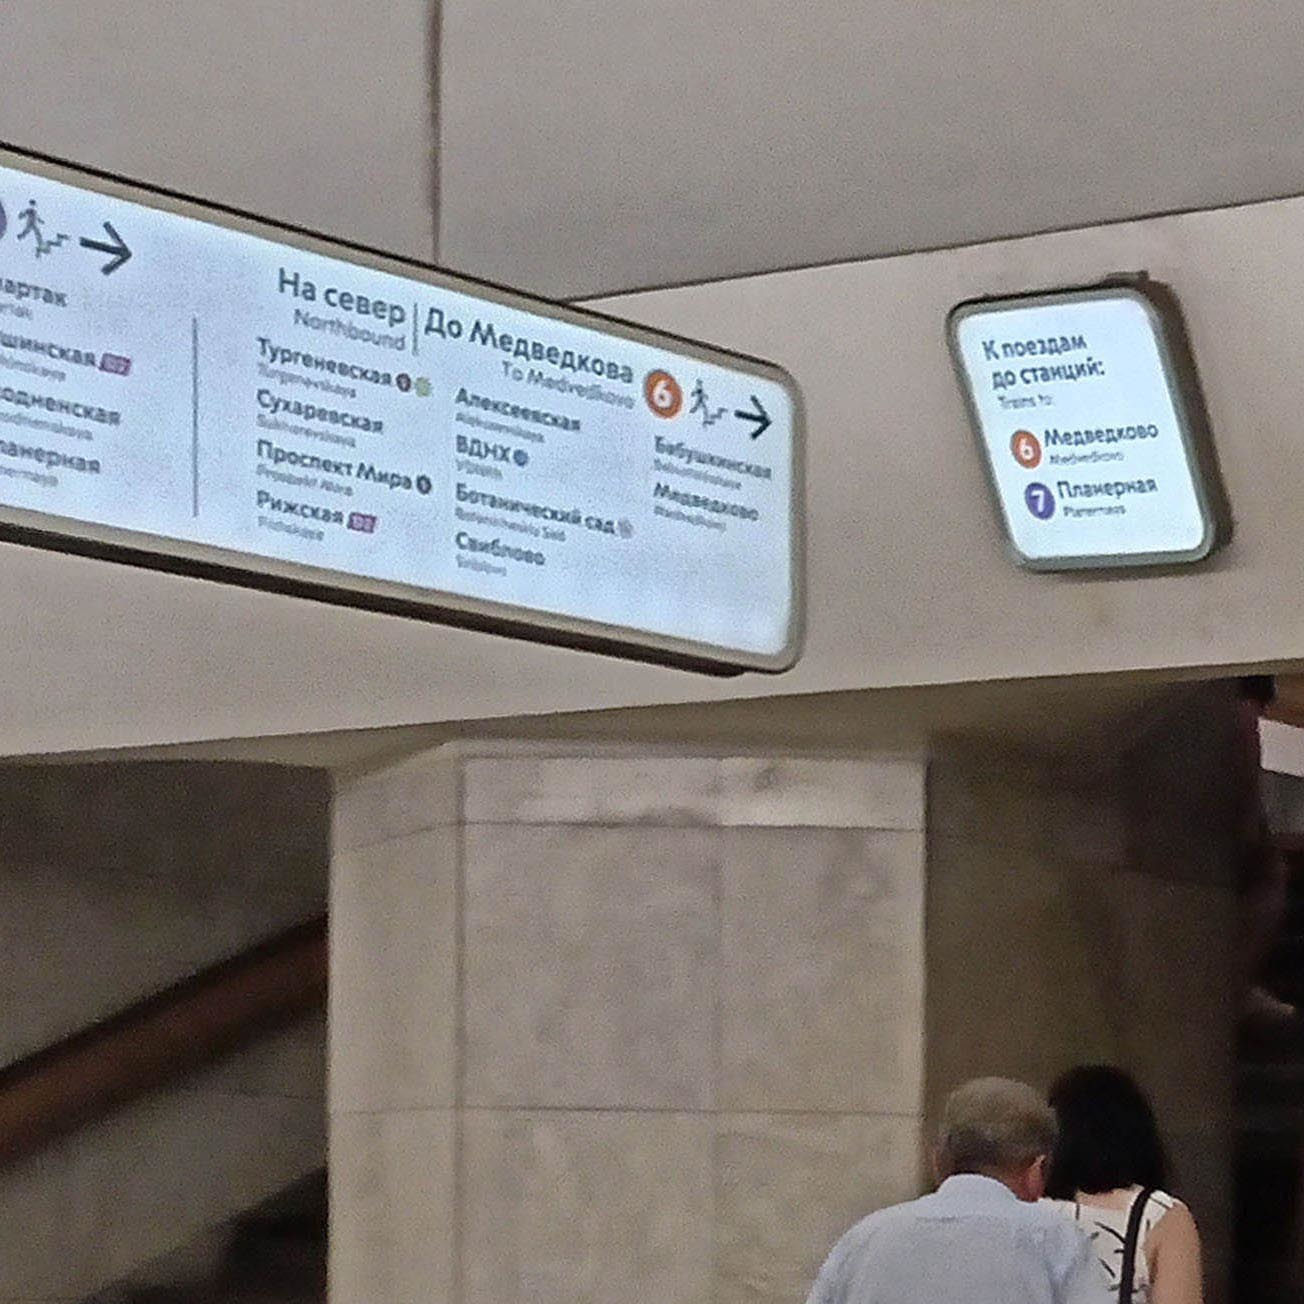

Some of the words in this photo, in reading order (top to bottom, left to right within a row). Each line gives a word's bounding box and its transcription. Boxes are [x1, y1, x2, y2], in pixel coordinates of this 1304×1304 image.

[278, 267, 316, 302] На
[324, 287, 406, 328] север
[294, 309, 406, 351] Northbound
[425, 307, 463, 339] До
[469, 319, 634, 384] Медведкова
[982, 339, 1000, 361] К
[1001, 335, 1088, 358] поездам
[256, 336, 392, 386] Тургеневская
[992, 369, 1016, 390] до
[1020, 356, 1105, 385] станций:
[256, 389, 384, 433] Сухаревская
[456, 434, 511, 463] ВДНХ
[1044, 424, 1159, 447] Медведково
[256, 439, 354, 477] Проспект
[356, 462, 413, 490] Мира
[257, 490, 344, 526] Рижская
[1057, 478, 1158, 499] Планерная
